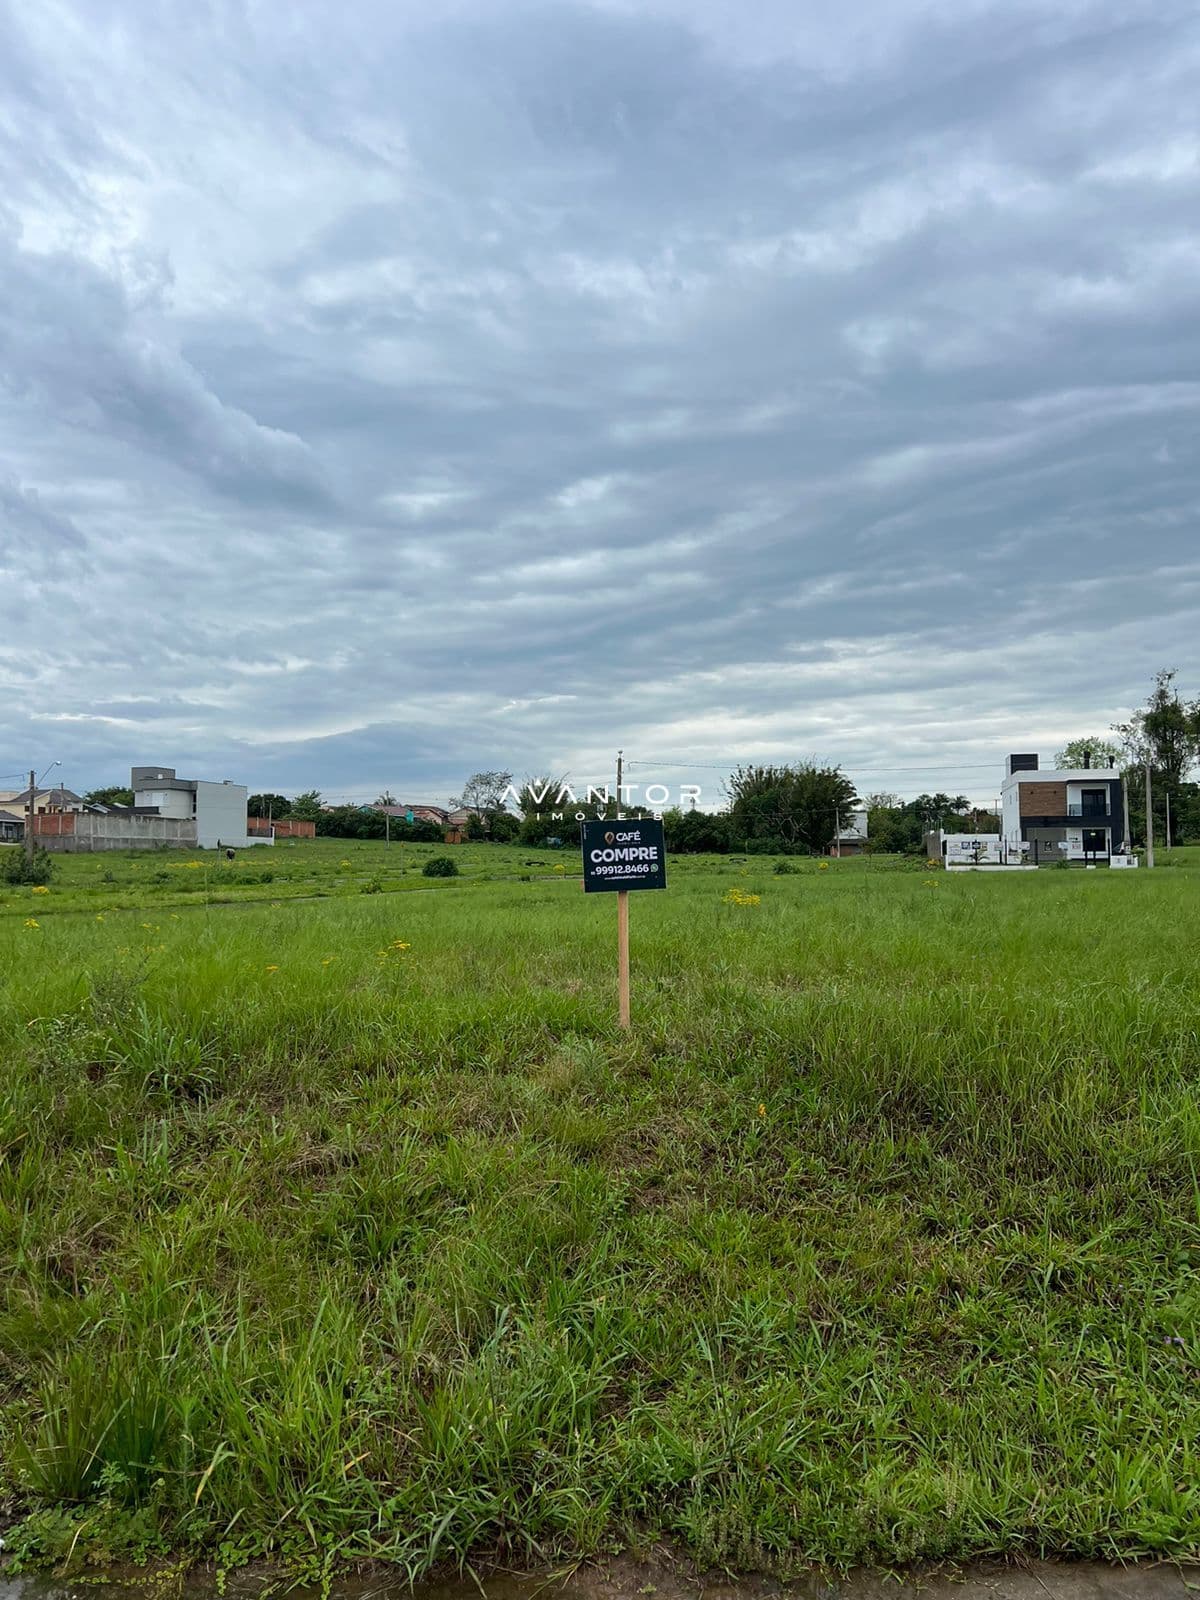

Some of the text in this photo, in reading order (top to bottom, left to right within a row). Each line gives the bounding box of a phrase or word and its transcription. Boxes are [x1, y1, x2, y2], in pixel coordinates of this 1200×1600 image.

[616, 830, 641, 841] CAFÉ
[590, 847, 658, 863] COMPRE
[595, 864, 649, 875] 99912.8466
